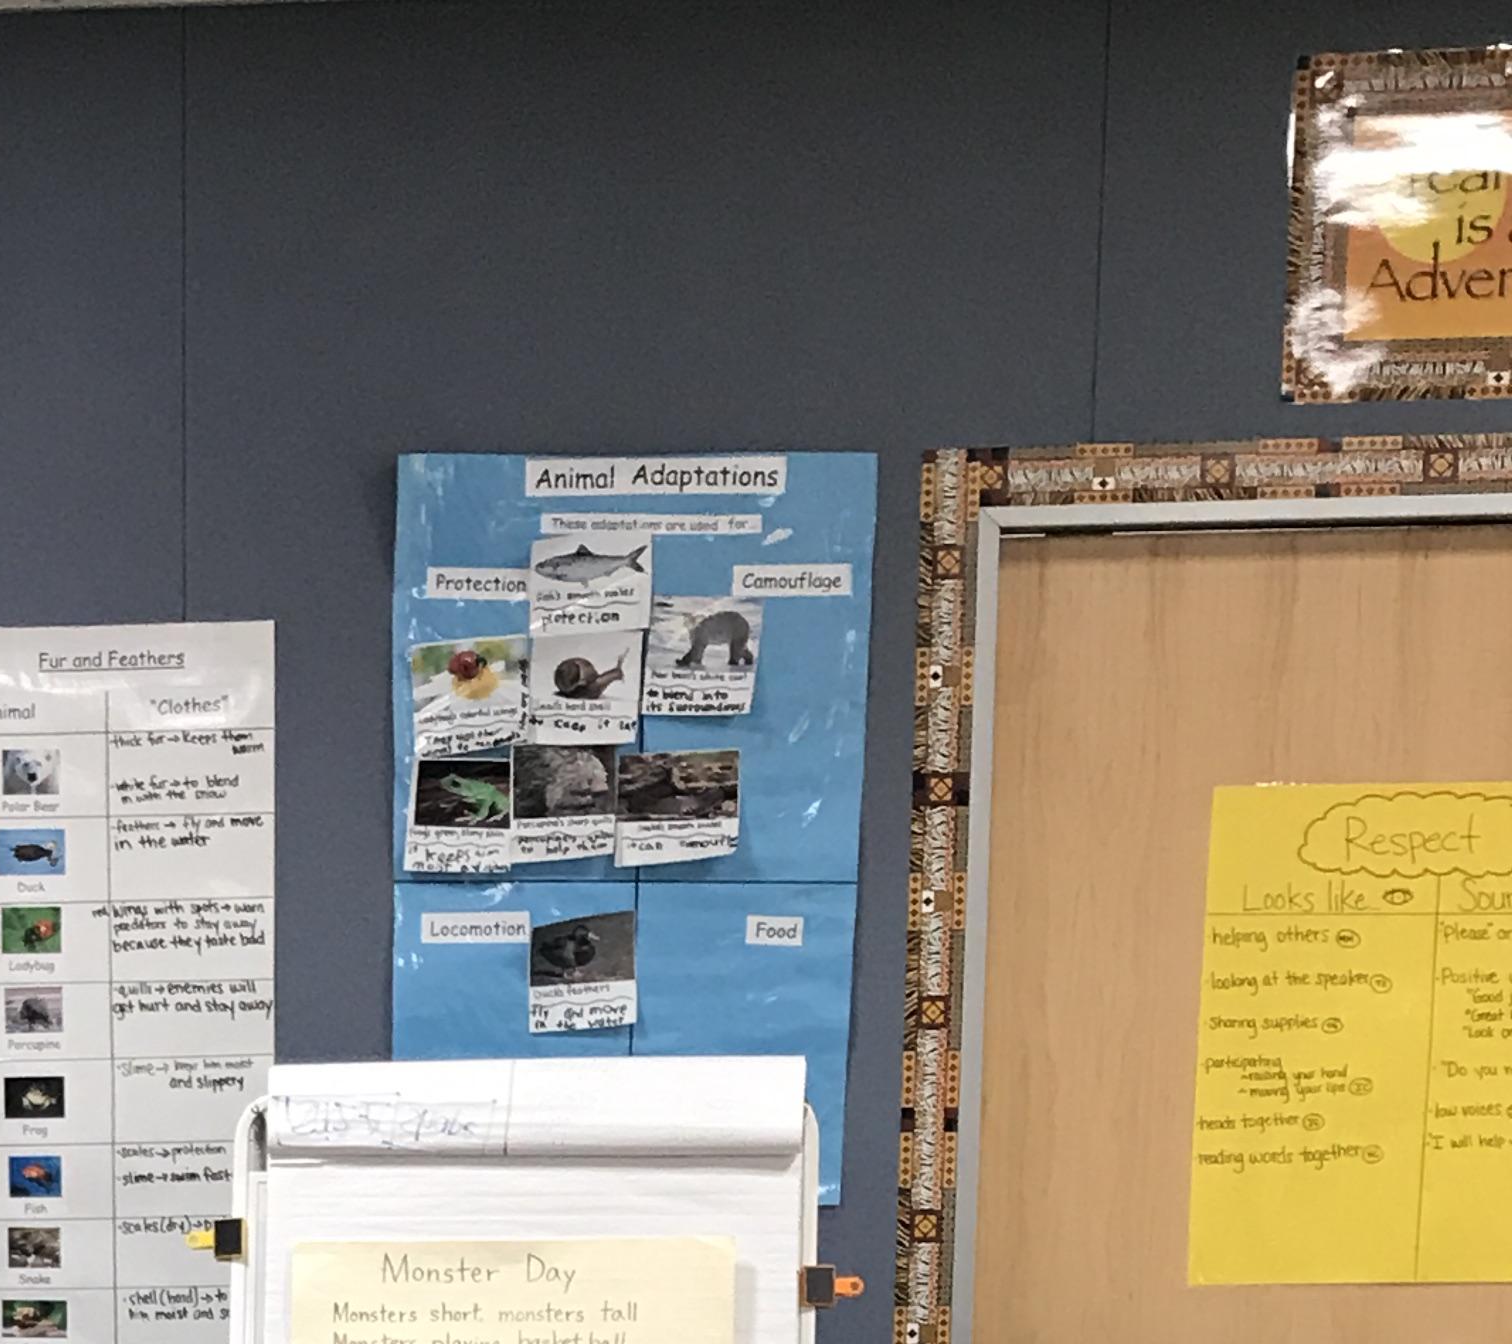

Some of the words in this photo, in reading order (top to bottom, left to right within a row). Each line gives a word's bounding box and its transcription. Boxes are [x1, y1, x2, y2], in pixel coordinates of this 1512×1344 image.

[535, 466, 615, 490] Animal
[632, 463, 780, 493] Adaptations
[435, 573, 527, 594] Protection
[741, 571, 843, 592] Camouflage
[39, 653, 68, 668] Fur
[73, 652, 102, 667] and
[108, 651, 185, 667] Feathers
[139, 836, 166, 848] the
[1345, 815, 1482, 863] Respect
[17, 882, 45, 894] Duck
[1243, 881, 1314, 912] Looks
[430, 917, 526, 937] Locomotion
[756, 921, 798, 940] Food
[113, 938, 167, 952] because
[170, 936, 202, 956] they
[1212, 926, 1268, 952] helping
[1277, 924, 1330, 944] others
[8, 960, 54, 974] Ladybug
[1441, 967, 1499, 985] Positive
[167, 982, 223, 995] enemies
[230, 980, 256, 993] will
[1262, 970, 1279, 985] at
[1285, 970, 1310, 985] the
[1315, 970, 1370, 990] speaker
[139, 998, 169, 1012] hurt
[175, 1000, 201, 1012] and
[205, 998, 235, 1020] stay
[239, 1000, 273, 1020] away
[1261, 1014, 1318, 1032] supplies
[1475, 1065, 1498, 1080] you
[169, 1076, 192, 1088] and
[197, 1076, 245, 1092] slippery
[1462, 1102, 1502, 1118] voices
[23, 1124, 47, 1137] Frog
[1241, 1112, 1299, 1133] together
[1450, 1134, 1473, 1149] will
[1478, 1133, 1505, 1150] help
[1198, 1149, 1245, 1174] reading
[1248, 1145, 1293, 1164] words
[1299, 1144, 1362, 1171] together
[24, 1202, 47, 1214] Fish
[381, 1252, 501, 1284] Monster
[526, 1252, 577, 1293] Day
[333, 1301, 418, 1324] Monsters
[498, 1302, 585, 1322] monsters
[601, 1300, 638, 1322] tall
